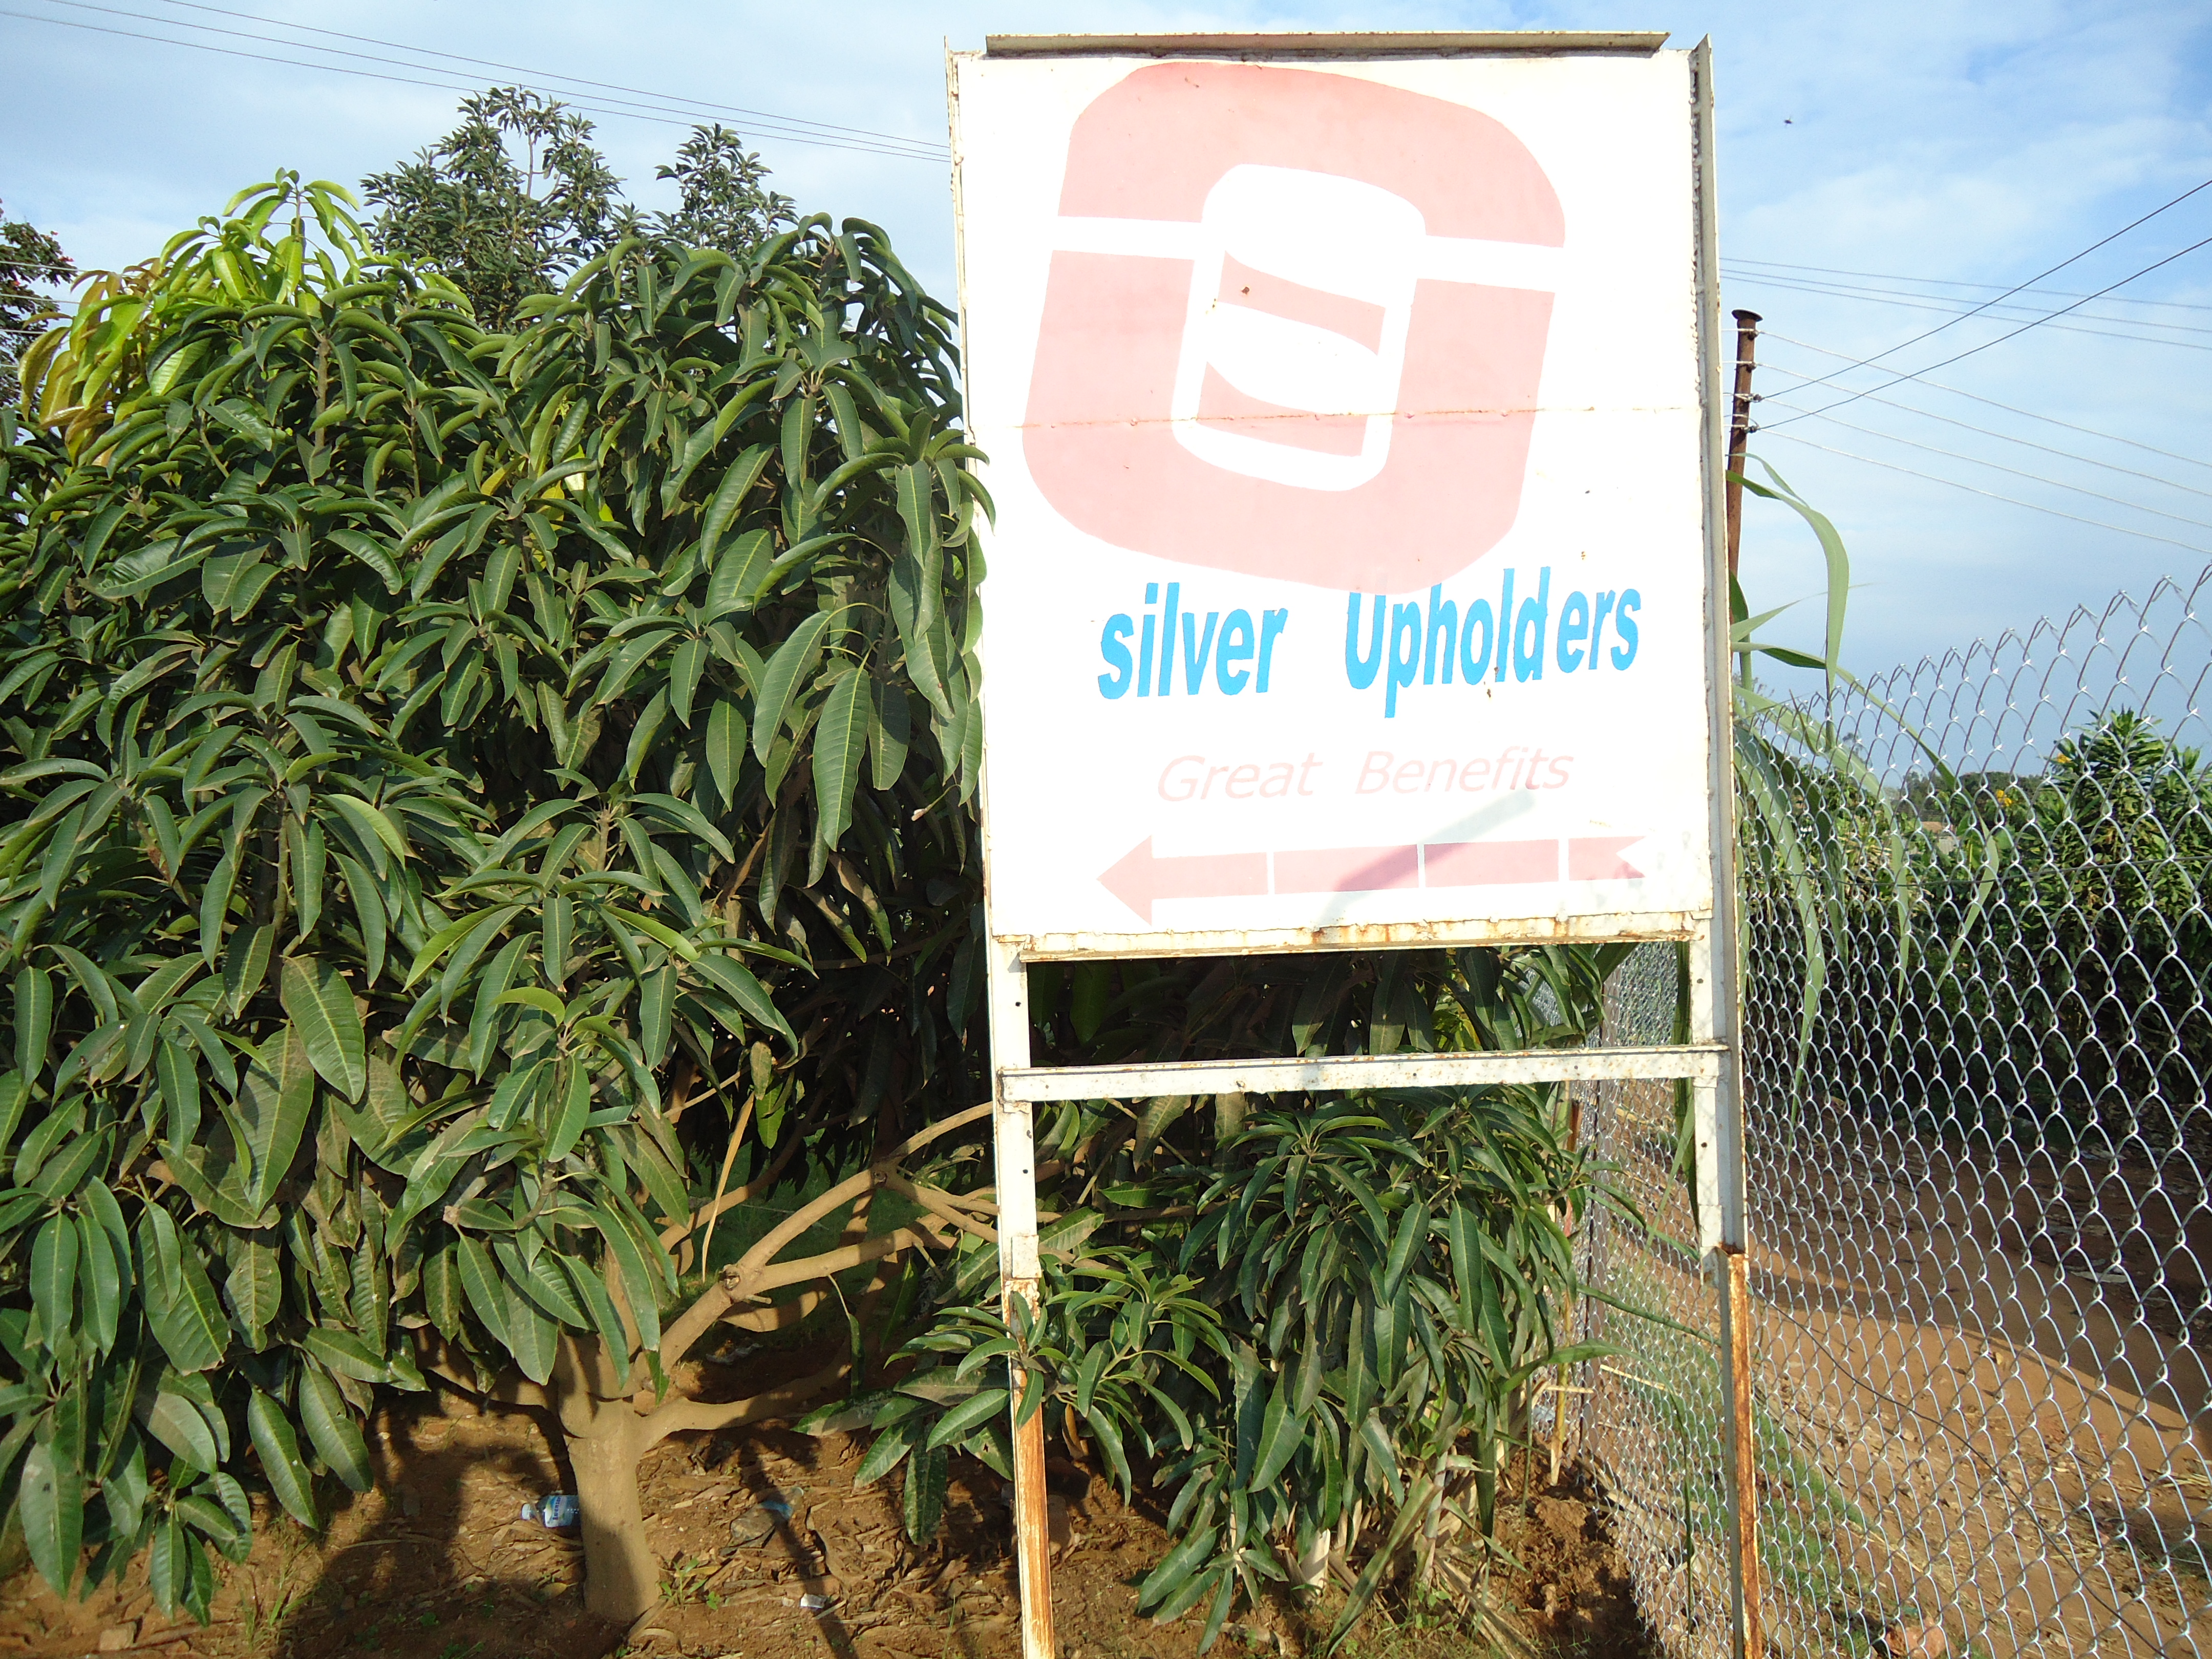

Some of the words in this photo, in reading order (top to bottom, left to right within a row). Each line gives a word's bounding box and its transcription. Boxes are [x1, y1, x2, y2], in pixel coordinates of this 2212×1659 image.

[1098, 582, 1288, 699] silver
[1345, 566, 1641, 718] Upholders
[1157, 752, 1324, 802] Great
[1355, 746, 1574, 795] Benefits
